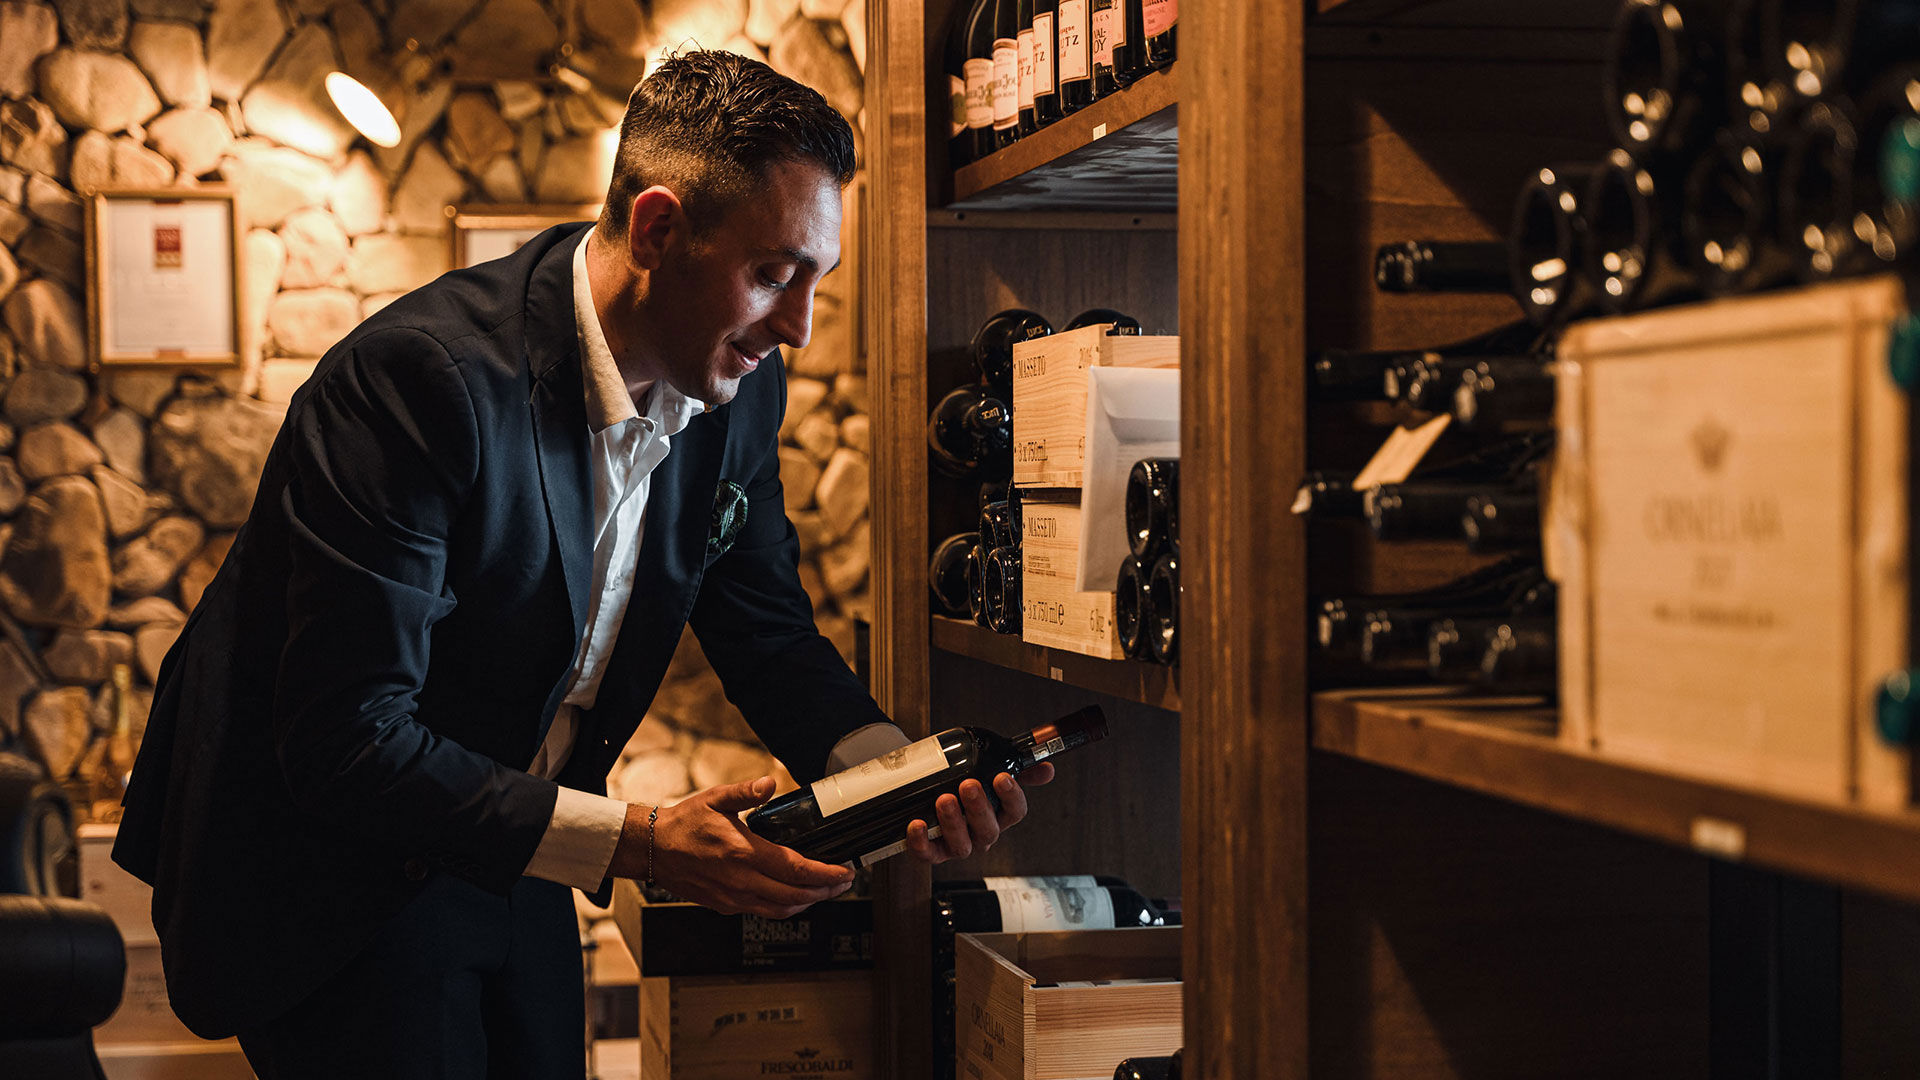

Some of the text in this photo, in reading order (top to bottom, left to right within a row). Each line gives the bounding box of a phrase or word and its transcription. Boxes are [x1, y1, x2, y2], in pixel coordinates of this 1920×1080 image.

[1018, 355, 1046, 378] MASSETO
[1028, 517, 1057, 538] MASSETO
[761, 1059, 854, 1075] FRESCOBALDI
